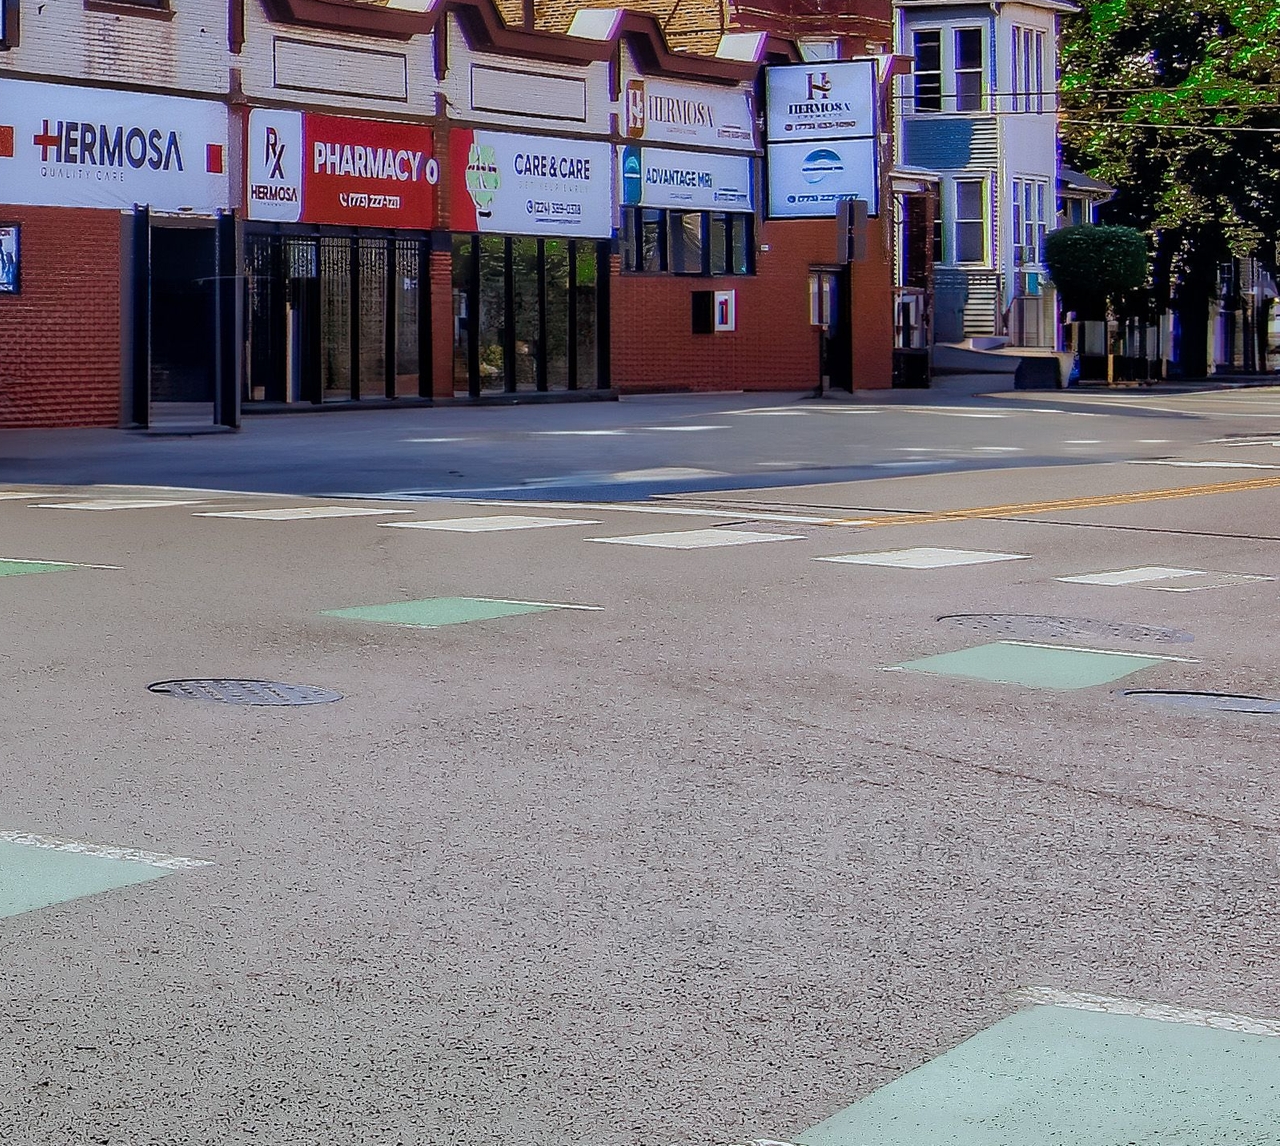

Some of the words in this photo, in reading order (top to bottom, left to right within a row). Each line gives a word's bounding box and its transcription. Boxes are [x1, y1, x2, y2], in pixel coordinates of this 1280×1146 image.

[788, 102, 852, 114] HERMOSA
[33, 118, 184, 172] HERMOSA
[313, 142, 422, 182] PHARMACY
[41, 167, 91, 180] QUALITY
[96, 170, 125, 182] CARE
[645, 167, 697, 187] ADVANTAGE
[251, 184, 298, 202] HERMOSA
